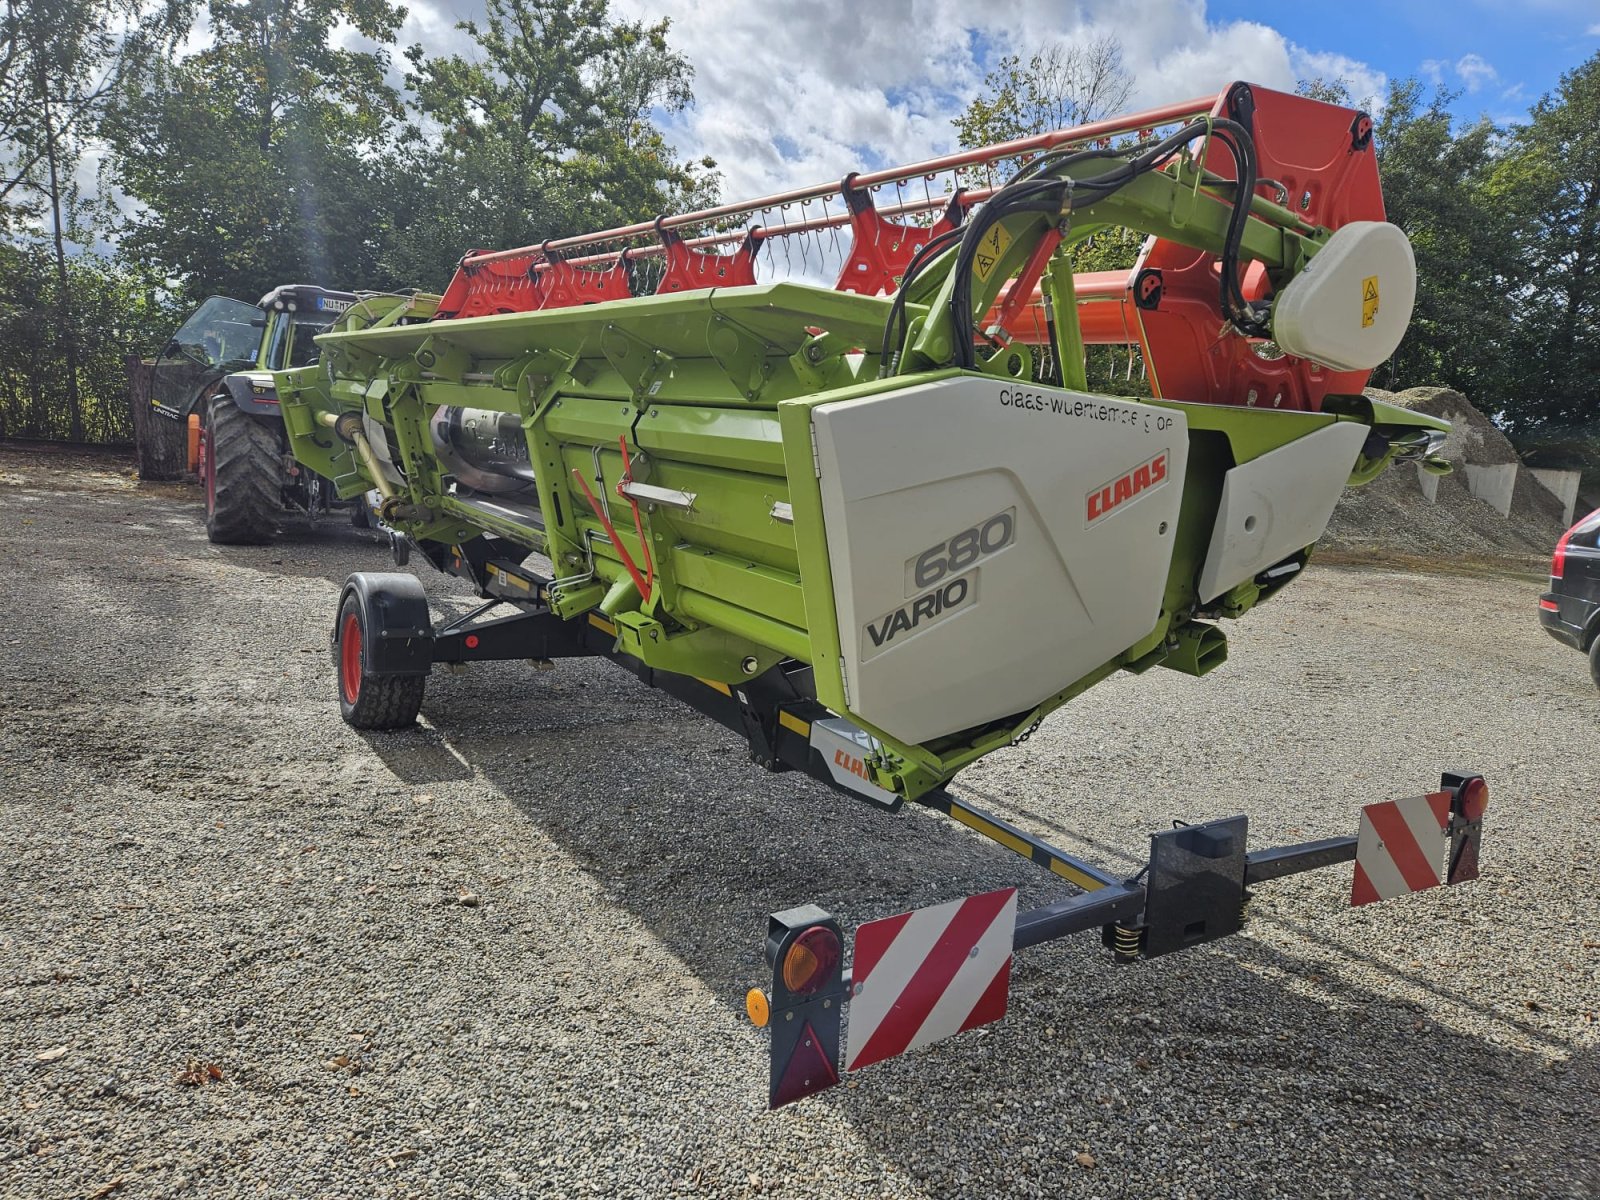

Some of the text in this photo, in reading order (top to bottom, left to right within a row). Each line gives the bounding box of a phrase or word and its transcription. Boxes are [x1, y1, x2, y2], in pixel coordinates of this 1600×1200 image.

[1087, 454, 1166, 522] CLAAS
[915, 513, 1013, 588] 680
[867, 578, 968, 647] VARIO
